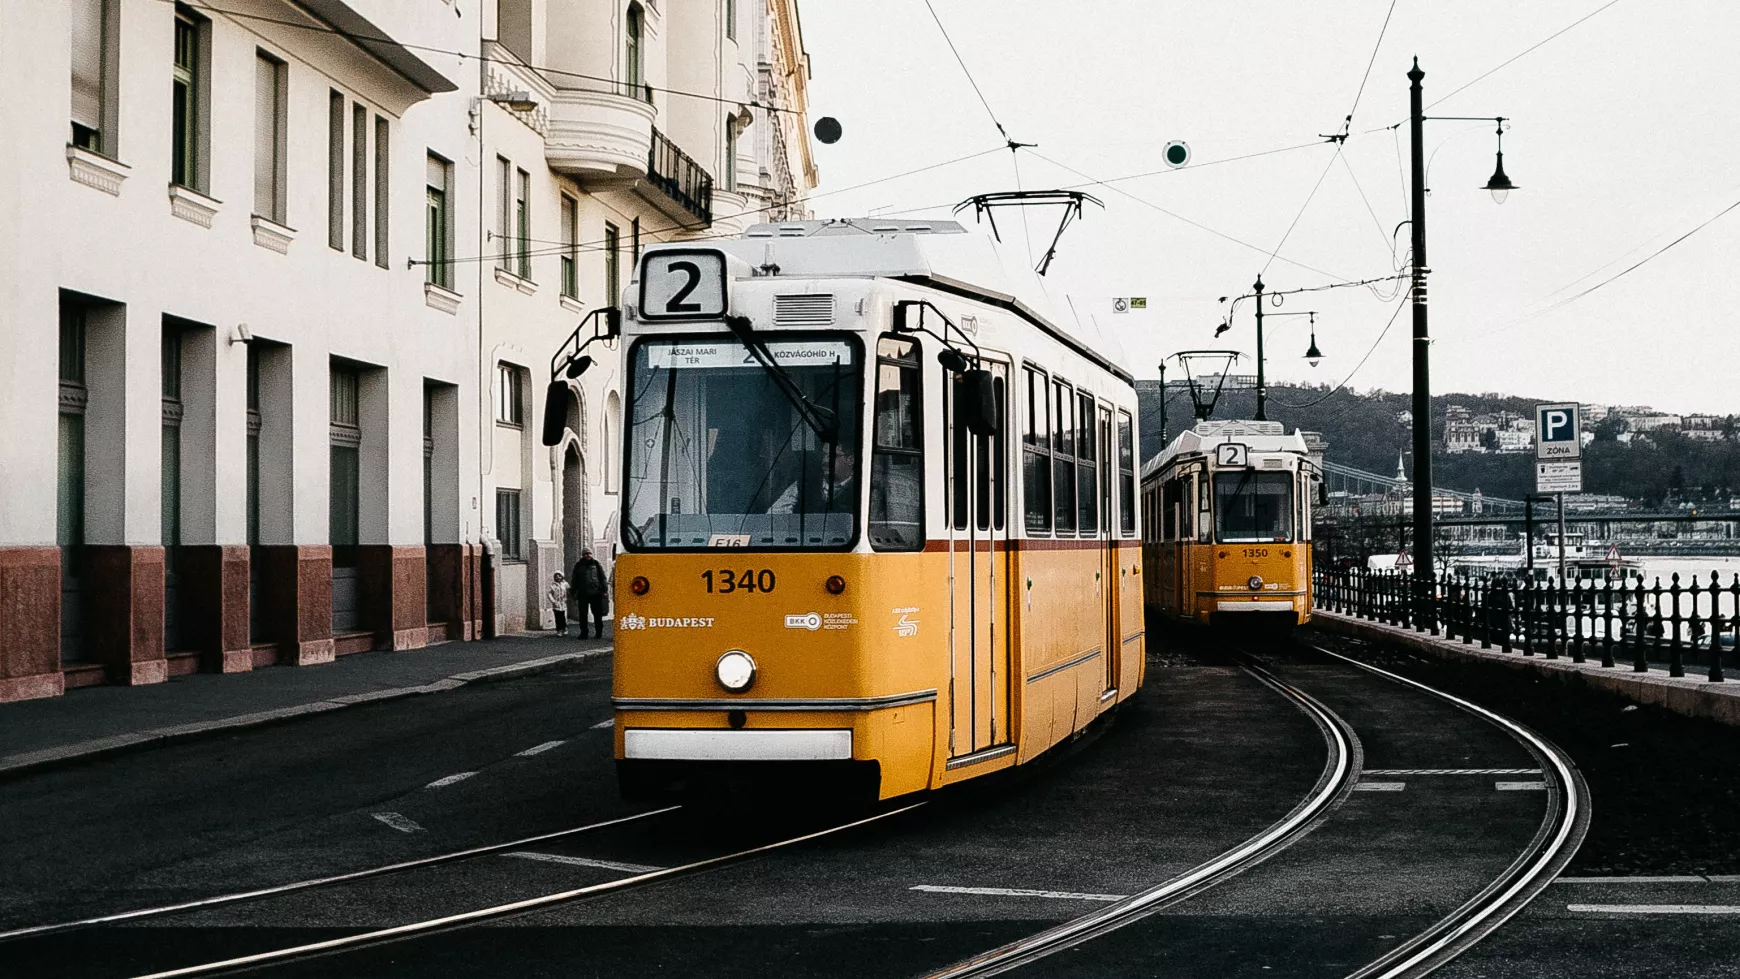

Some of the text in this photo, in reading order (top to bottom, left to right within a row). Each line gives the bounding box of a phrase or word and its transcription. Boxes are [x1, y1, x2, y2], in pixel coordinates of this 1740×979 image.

[665, 261, 702, 313] 2
[668, 347, 717, 356] JÁSZAI MARI
[829, 350, 836, 358] H
[685, 356, 700, 364] TÉR
[1546, 410, 1568, 440] P
[1225, 446, 1239, 465] 2
[1546, 446, 1571, 455] ZÓNA
[1242, 548, 1269, 558] 1350
[701, 569, 776, 594] 1340
[648, 617, 715, 628] BUDAPEST
